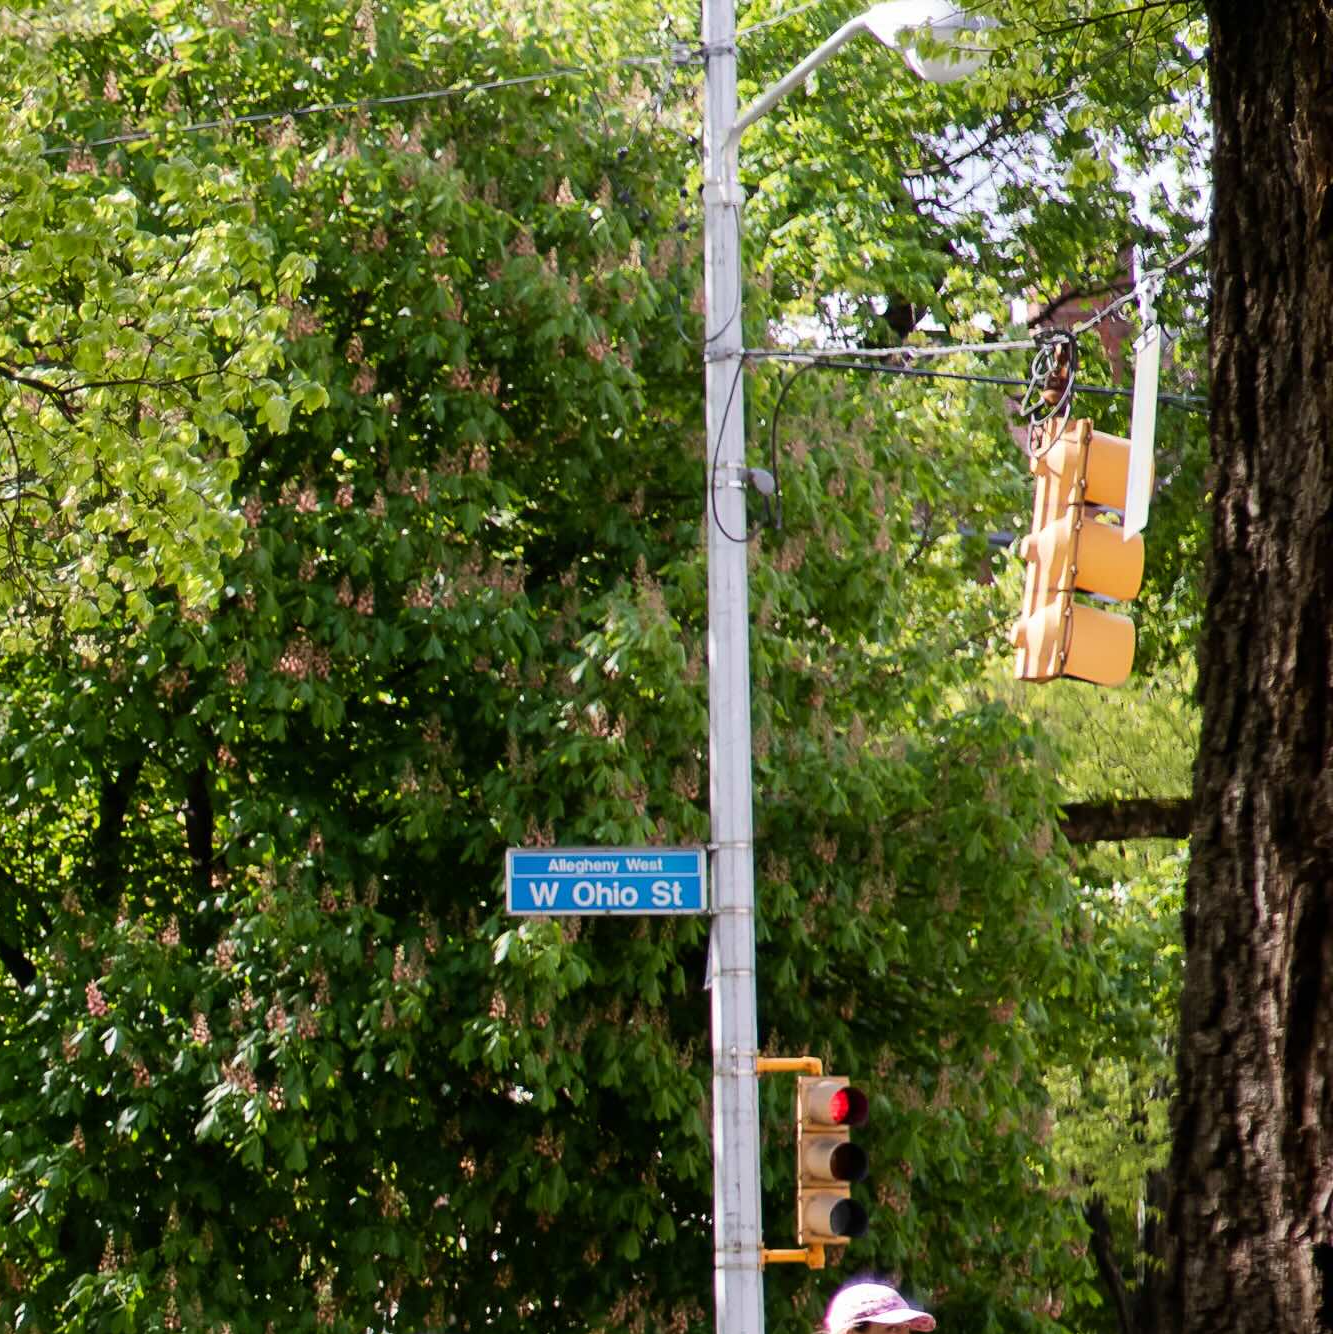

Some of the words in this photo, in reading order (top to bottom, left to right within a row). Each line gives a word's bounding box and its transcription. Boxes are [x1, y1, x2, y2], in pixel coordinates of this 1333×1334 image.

[548, 858, 619, 873] Allegheny
[626, 857, 663, 872] West
[529, 882, 559, 907] W
[572, 880, 639, 907] Ohio
[651, 880, 683, 907] St
